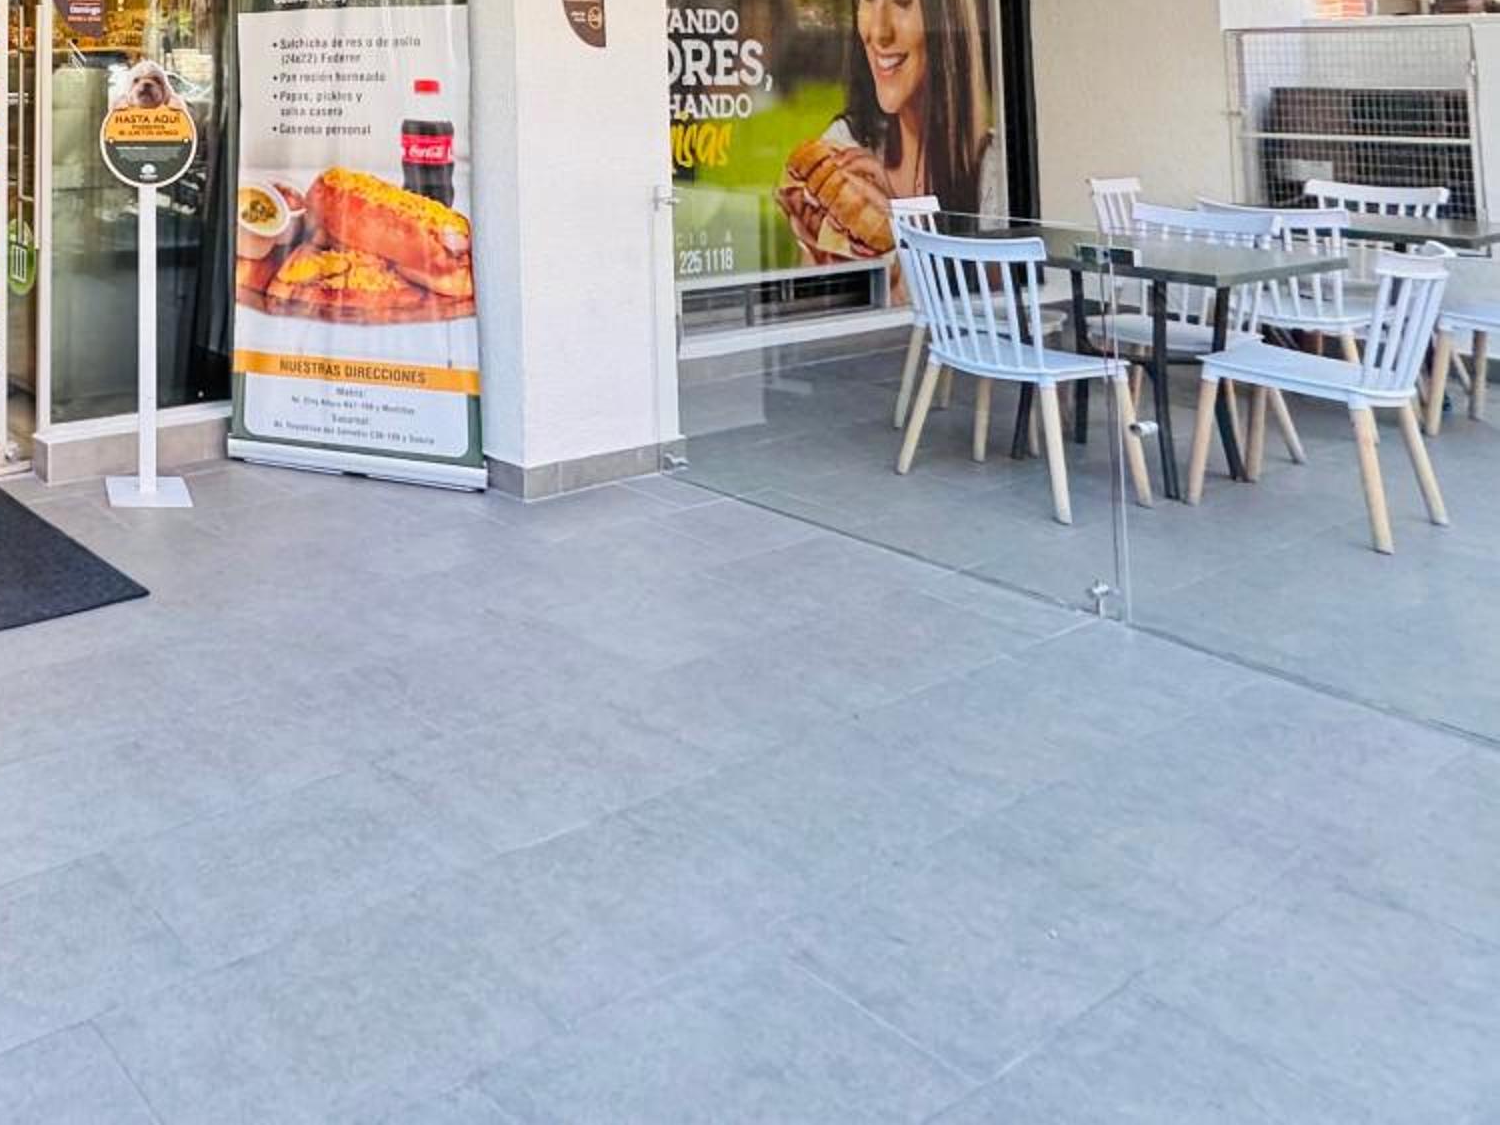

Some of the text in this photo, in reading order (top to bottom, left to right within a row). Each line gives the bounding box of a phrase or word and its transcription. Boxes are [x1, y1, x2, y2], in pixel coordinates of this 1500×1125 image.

[666, 8, 739, 34] ANDO
[115, 115, 150, 124] HASTA
[280, 358, 426, 384] NUESTRAS DIRECCIONES
